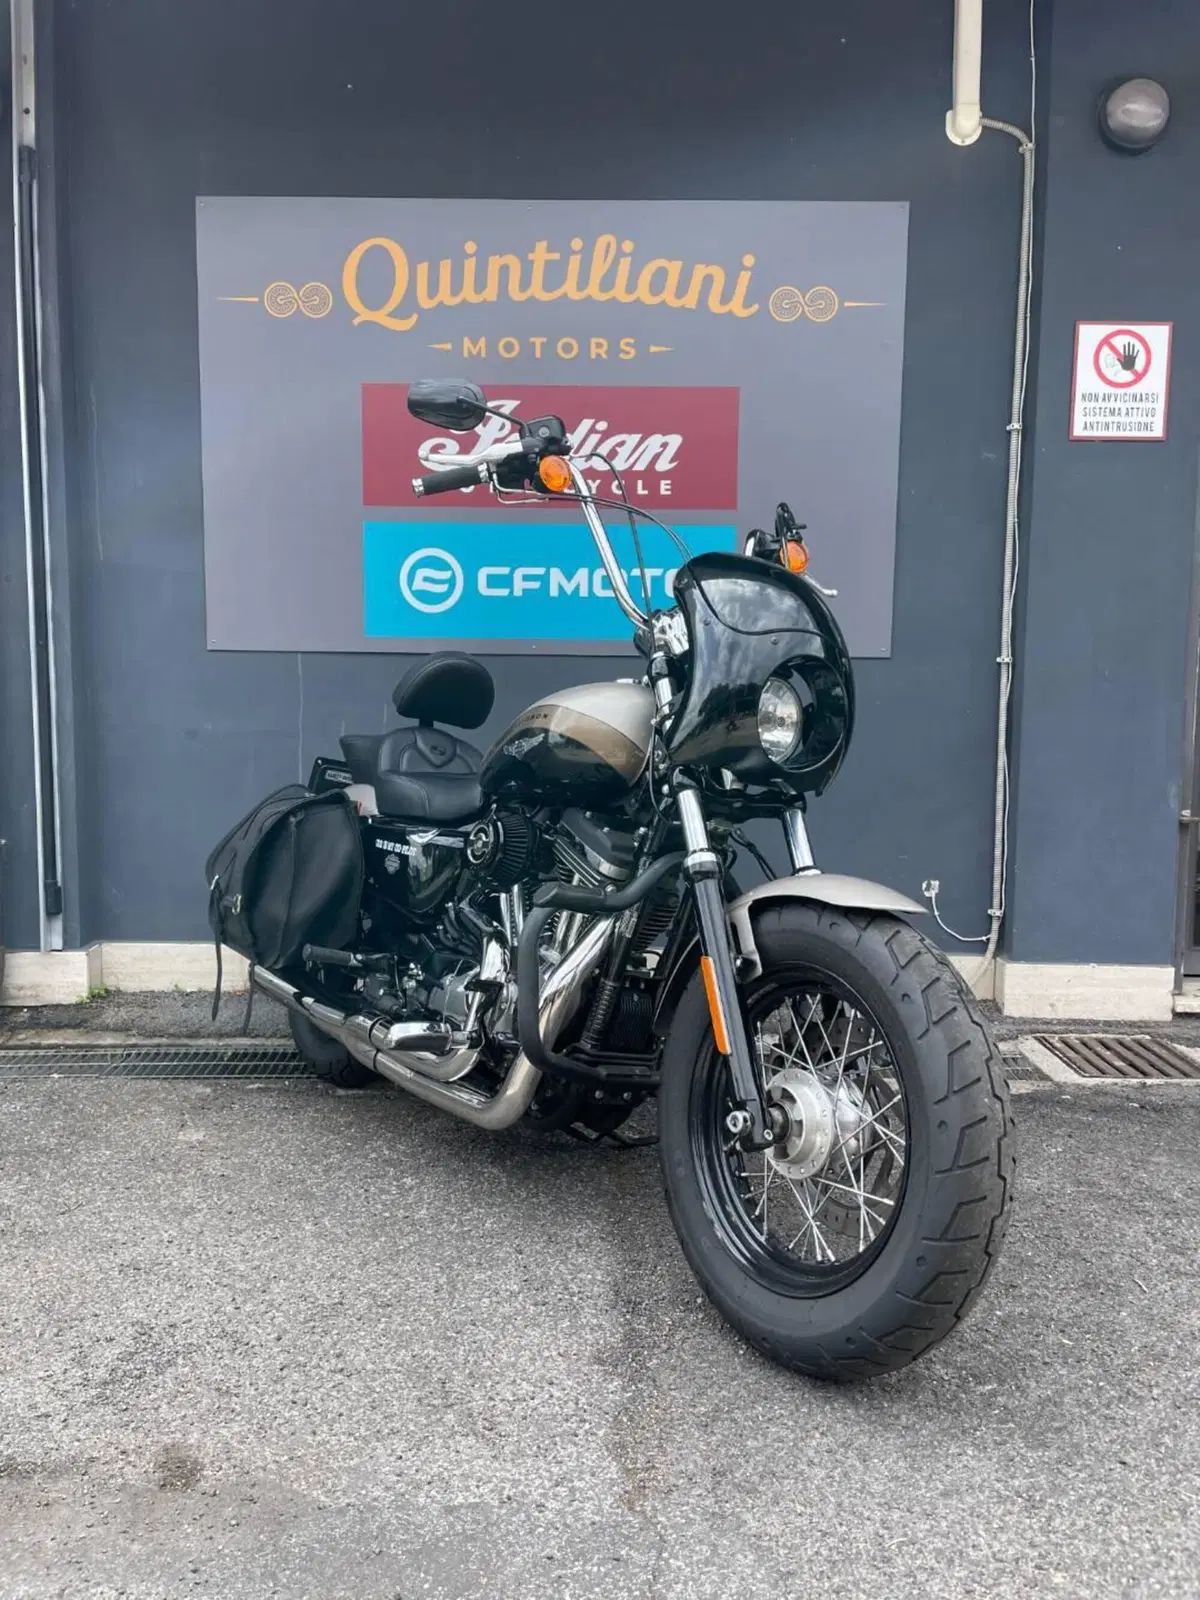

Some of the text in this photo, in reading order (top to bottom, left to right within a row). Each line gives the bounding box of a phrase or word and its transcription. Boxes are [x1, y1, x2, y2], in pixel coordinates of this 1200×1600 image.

[342, 233, 760, 331] Quintiliani
[462, 336, 638, 360] MOTORS
[1081, 393, 1159, 403] NON AVVICINARSI
[1082, 406, 1156, 418] SISTEMA ATTIVO
[1082, 421, 1155, 432] ANTINTRUSIONE
